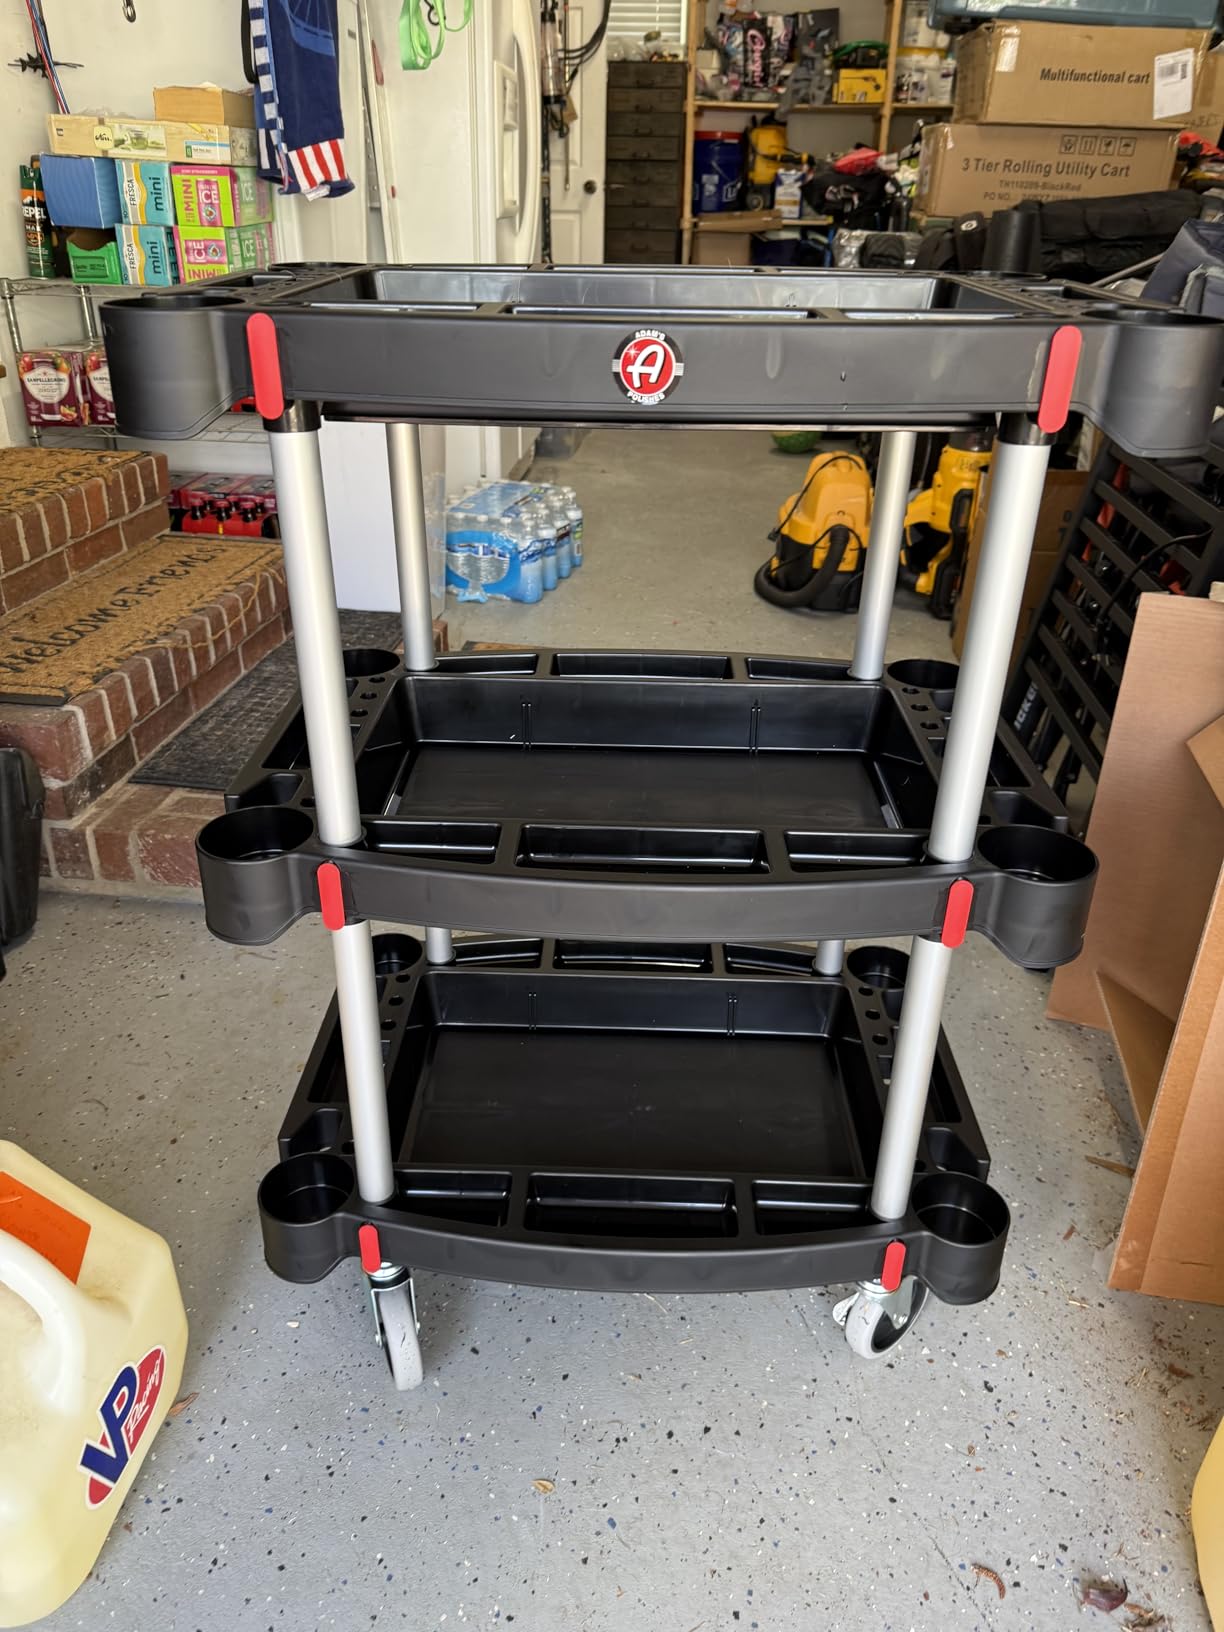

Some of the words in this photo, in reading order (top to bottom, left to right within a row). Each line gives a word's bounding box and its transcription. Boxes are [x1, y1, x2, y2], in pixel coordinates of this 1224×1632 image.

[1040, 68, 1126, 84] Multifunctional
[1127, 71, 1151, 85] cart
[962, 158, 970, 172] 3
[973, 158, 1000, 172] Tier
[1002, 160, 1052, 177] Rolling
[1055, 161, 1098, 180] Utility
[1100, 163, 1131, 177] Cart
[127, 179, 137, 206] FRESCA
[149, 177, 165, 212] mini
[182, 179, 195, 212] MINI
[199, 190, 220, 204] ICE
[126, 243, 137, 270] FRESCA
[147, 241, 162, 274] mini
[194, 241, 206, 262] ICE
[635, 329, 666, 341] ADAM'S
[626, 343, 666, 388] A
[627, 390, 665, 404] POLISHES
[126, 1351, 163, 1443] Racing
[80, 1364, 138, 1485] VP
